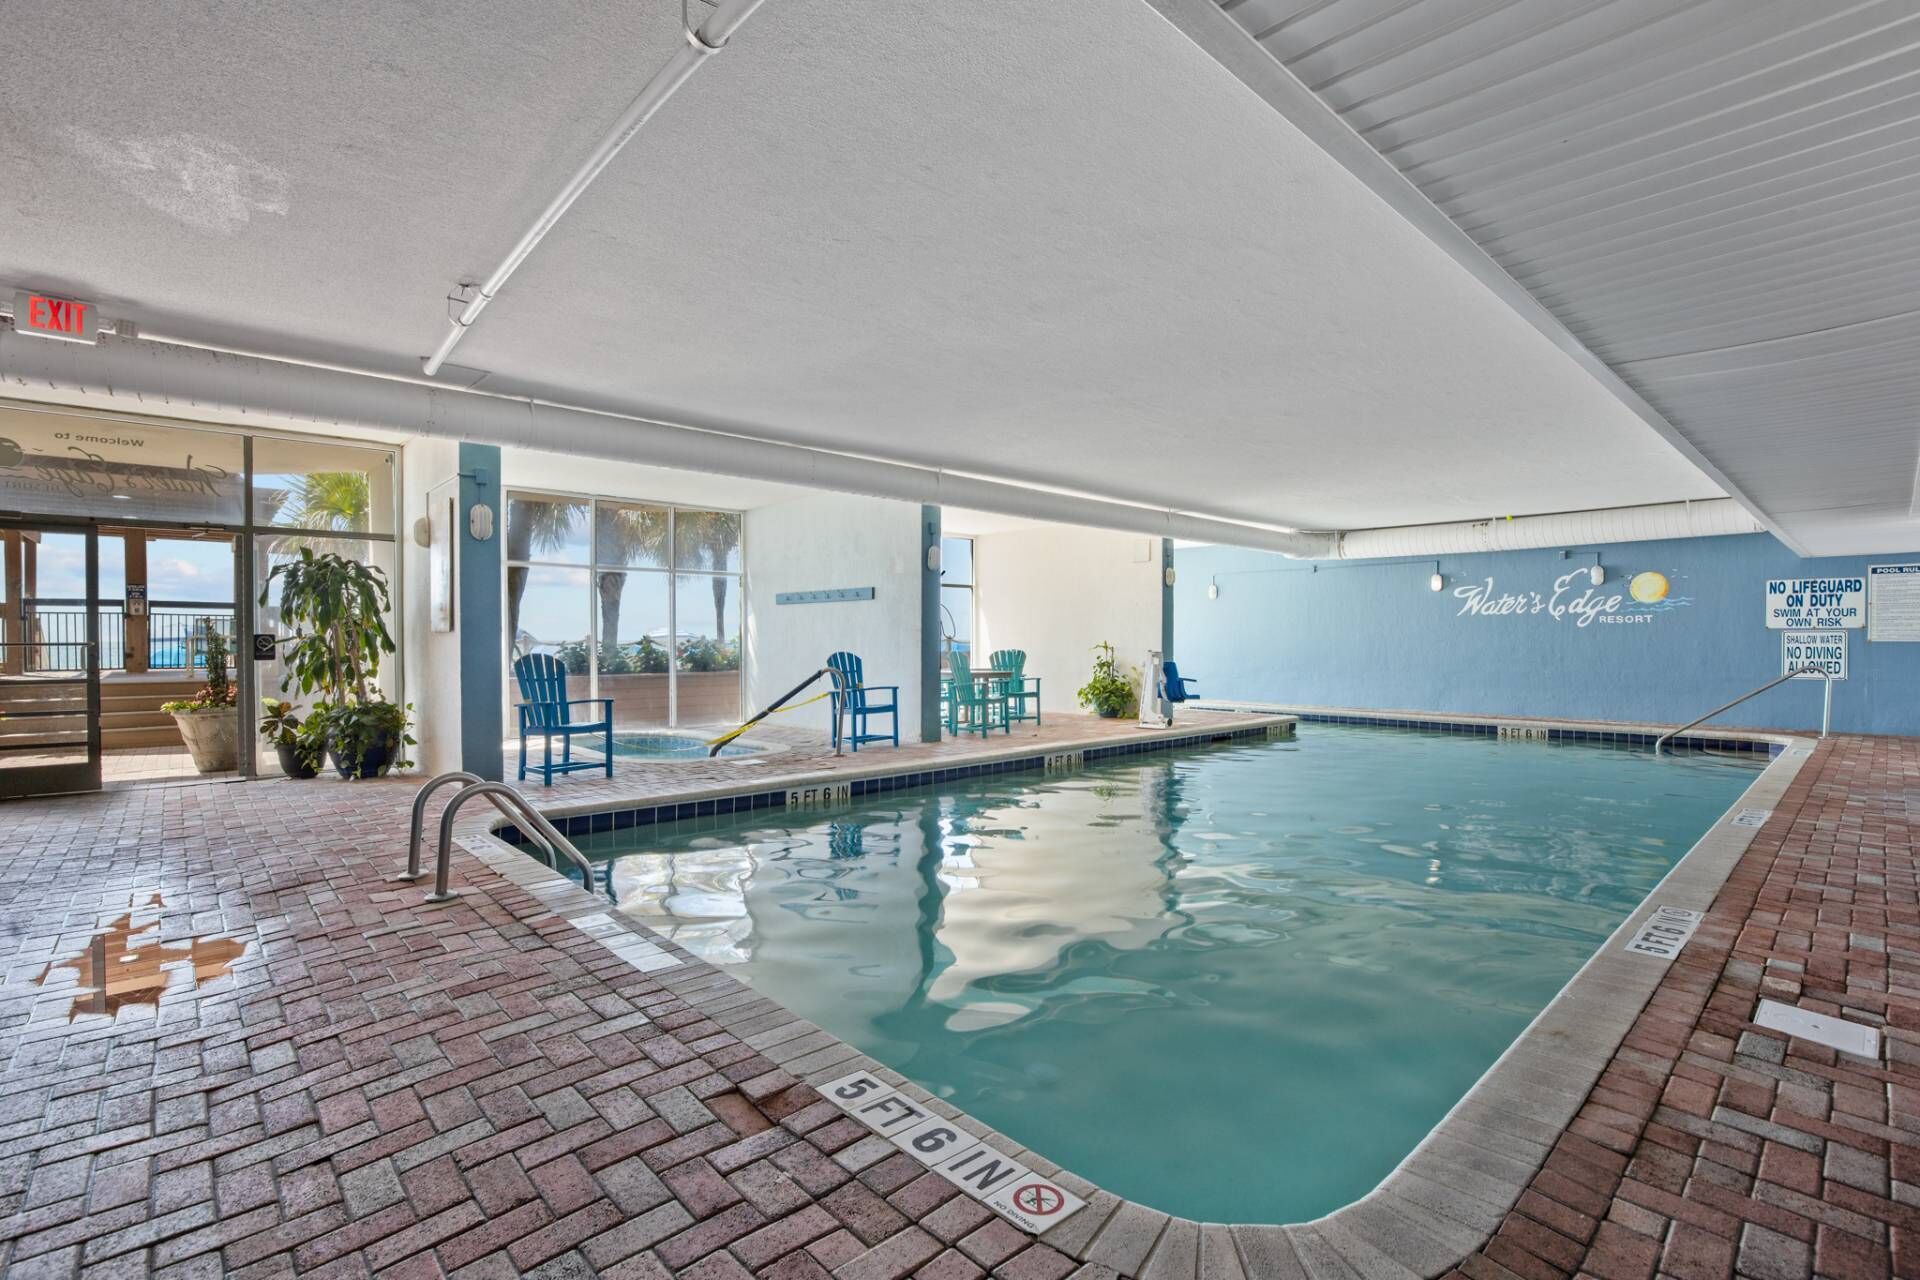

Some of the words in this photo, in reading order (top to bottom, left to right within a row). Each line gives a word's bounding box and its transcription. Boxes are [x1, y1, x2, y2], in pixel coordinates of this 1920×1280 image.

[29, 295, 87, 336] EXIT
[1769, 581, 1786, 594] NO
[1792, 579, 1862, 593] LIFEGUARD
[1453, 577, 1546, 617] Water's
[1548, 567, 1623, 628] Edge
[1786, 595, 1803, 607] ON
[1810, 594, 1843, 607] DUTY
[1599, 614, 1654, 624] RESORT
[1773, 608, 1801, 618] SWIM
[1806, 608, 1820, 617] AT
[1826, 607, 1857, 617] YOUR
[1786, 618, 1811, 627] OWN
[1817, 618, 1842, 626] RISK
[1786, 635, 1817, 644] SHALLOW
[1820, 635, 1843, 644] WATER
[1786, 647, 1801, 660] NO
[1805, 647, 1842, 660] DIVING
[1055, 755, 1064, 769] FT
[791, 792, 798, 805] 5
[804, 789, 818, 805] FT
[823, 787, 831, 801] 6
[837, 784, 849, 802] IN
[1656, 915, 1694, 928] IN
[1651, 925, 1686, 935] 6
[1641, 932, 1680, 947] FT
[1634, 944, 1670, 954] 5
[834, 1078, 879, 1099] 5
[859, 1096, 926, 1128] FT
[911, 1127, 958, 1153] 6
[947, 1150, 1016, 1190] IN
[993, 1200, 1007, 1210] NO
[1006, 1209, 1035, 1229] DIVING
